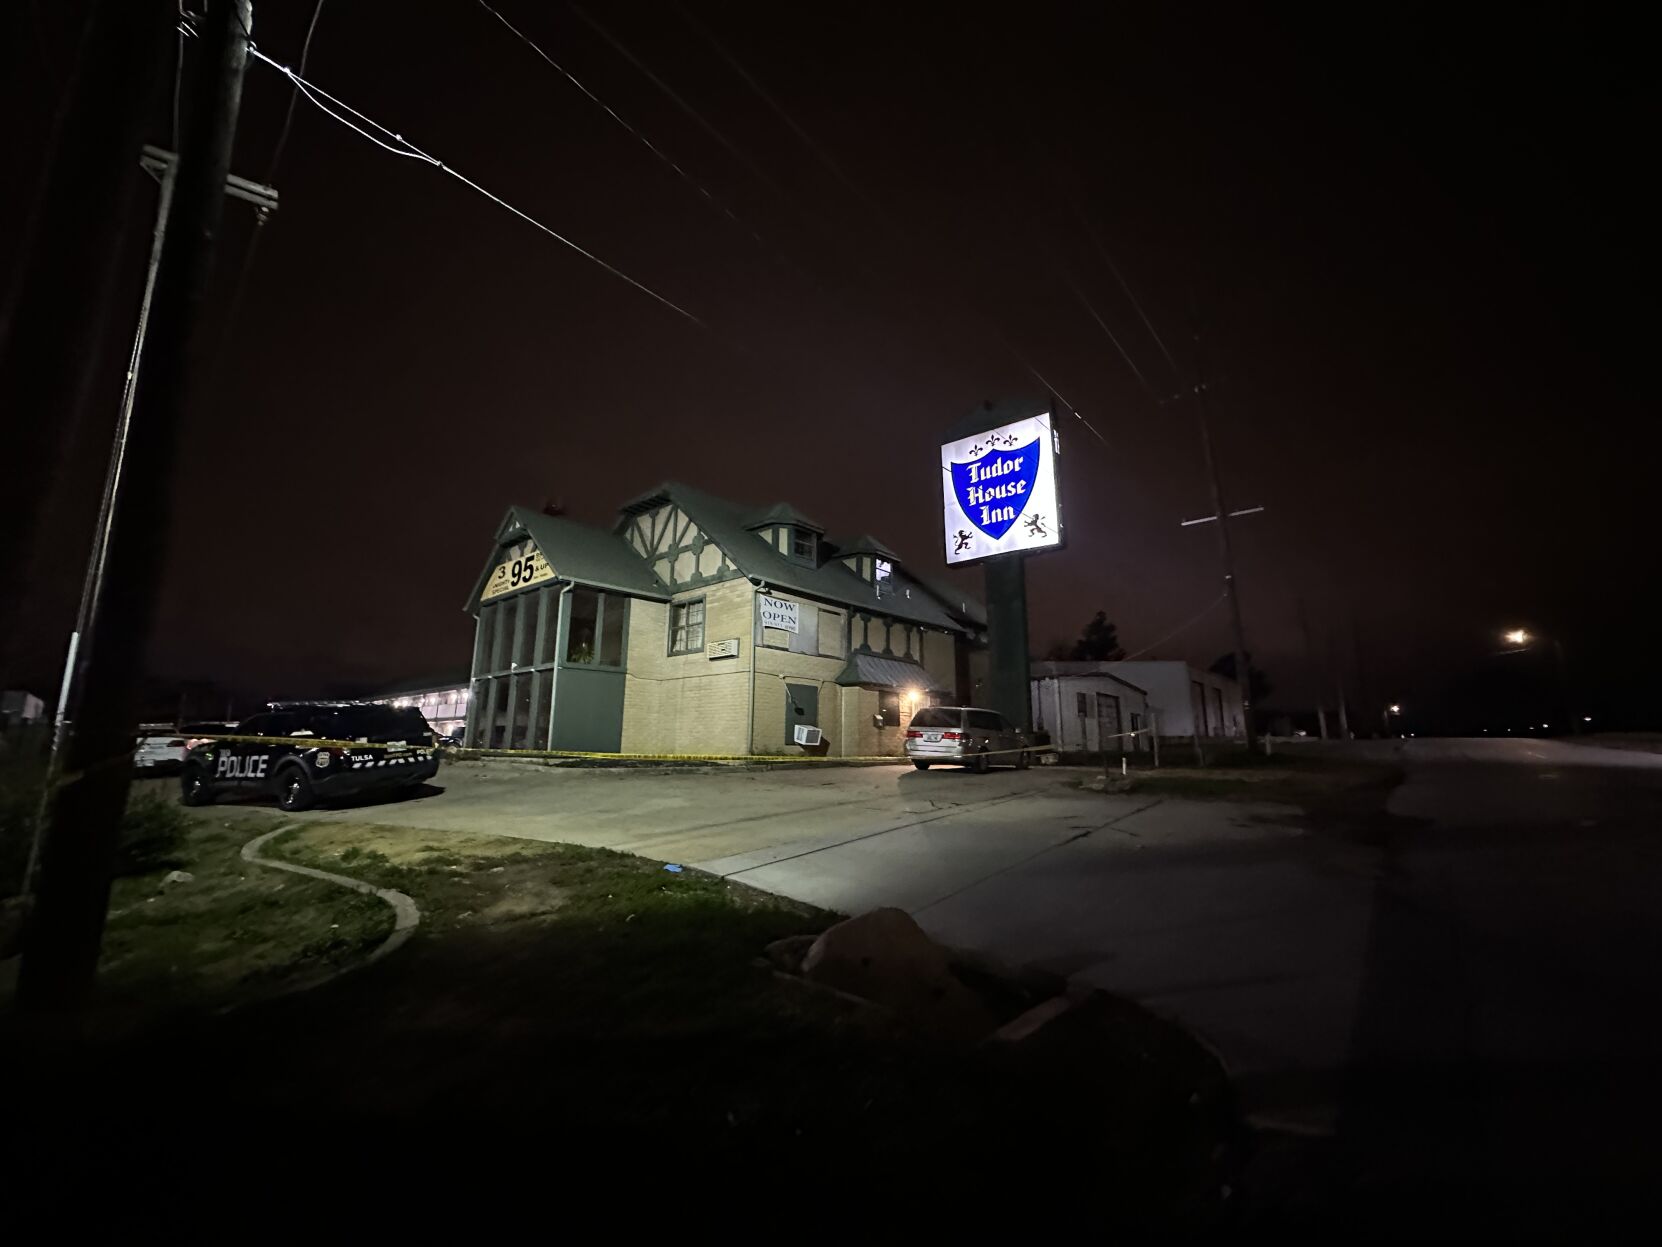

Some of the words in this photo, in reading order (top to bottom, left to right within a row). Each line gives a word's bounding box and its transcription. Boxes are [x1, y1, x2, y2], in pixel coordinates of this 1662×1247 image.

[966, 456, 1024, 484] Tudor
[966, 479, 1027, 507] House
[980, 504, 1016, 526] Inn
[498, 566, 506, 579] 3
[510, 555, 535, 587] 95
[764, 597, 796, 612] NOW
[762, 610, 797, 625] OPEN
[216, 754, 269, 778] POLICE
[351, 754, 373, 762] TULSA
